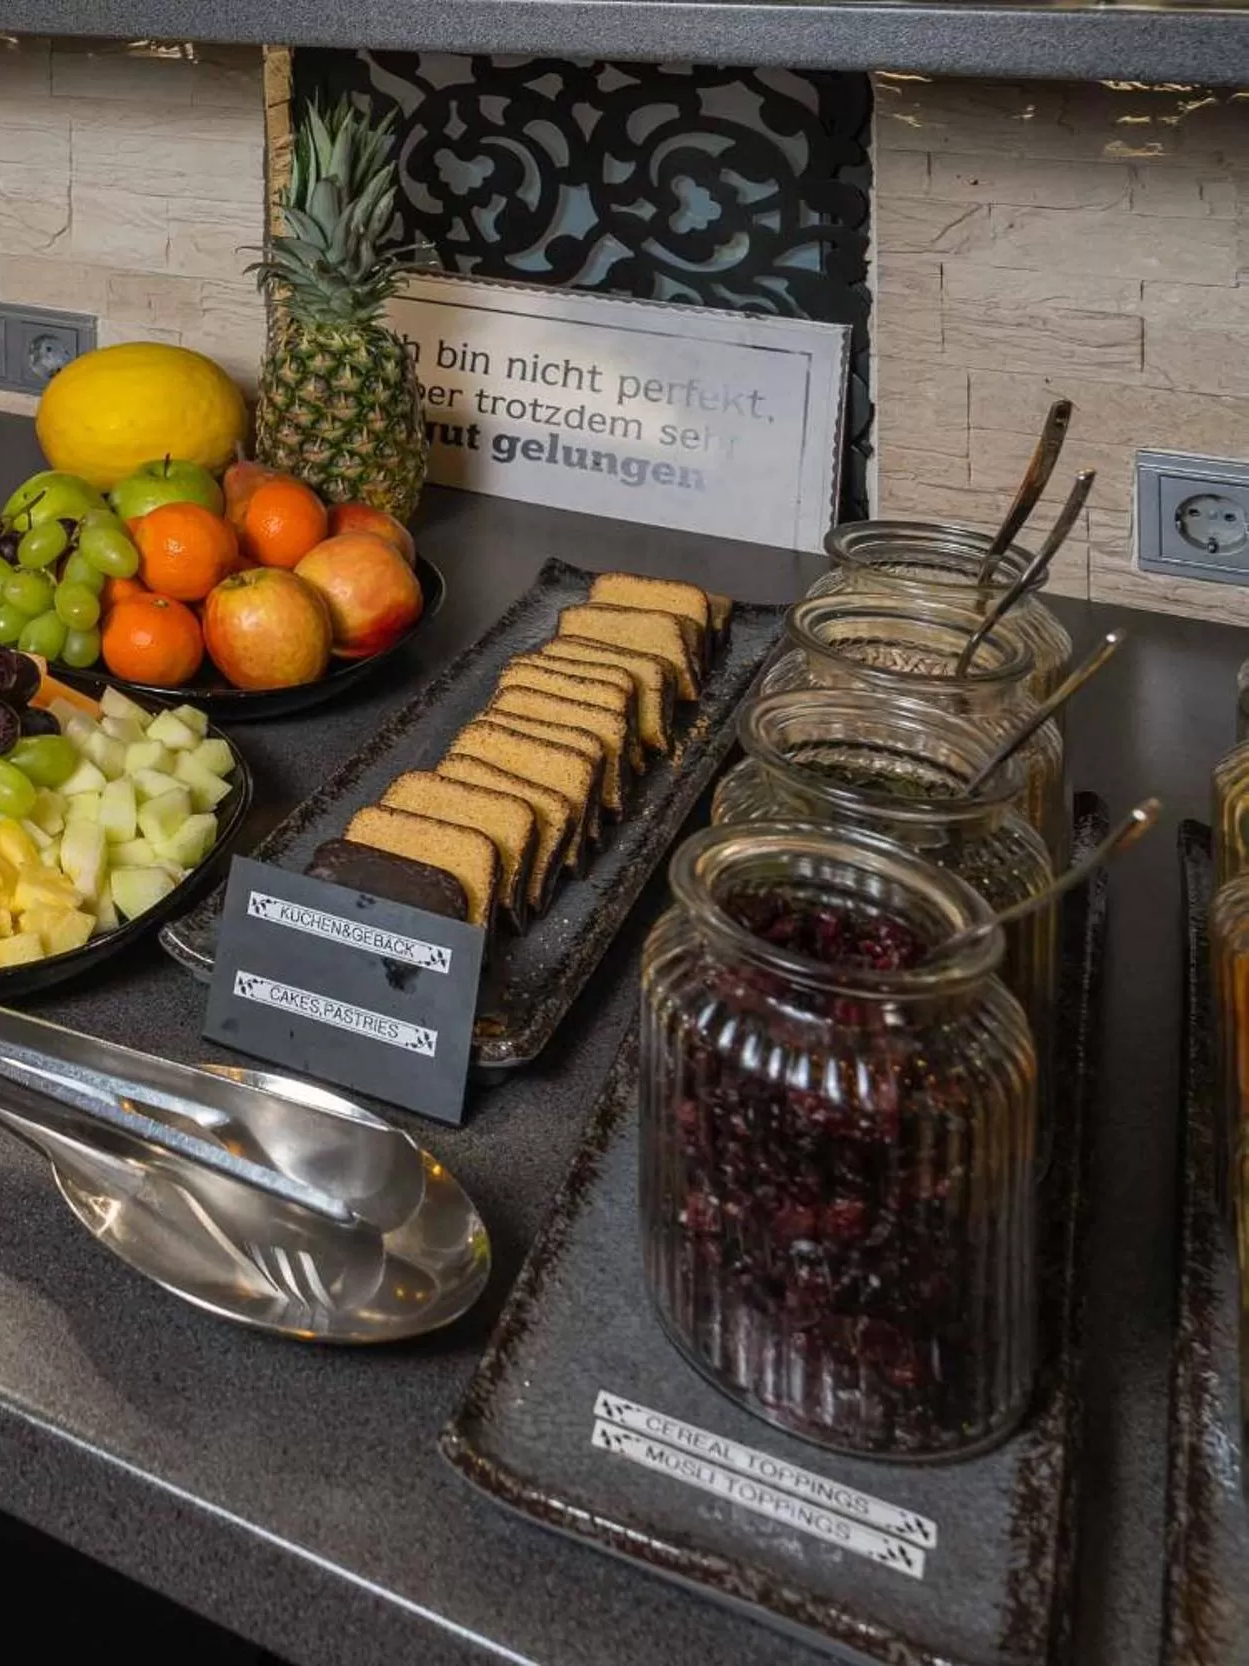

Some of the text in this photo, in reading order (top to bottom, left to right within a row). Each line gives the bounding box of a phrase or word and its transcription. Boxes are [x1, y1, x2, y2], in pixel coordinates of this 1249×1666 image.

[436, 339, 490, 375] bin
[507, 353, 603, 394] nicht
[617, 374, 775, 424] perfekt.
[475, 388, 643, 440] trotzdem
[491, 431, 705, 492] gelungen
[269, 986, 399, 1039] CAKES,PASTRIES
[645, 1415, 870, 1515] CEREAL TOPPINGS
[725, 1475, 851, 1541] TOPPINGS
